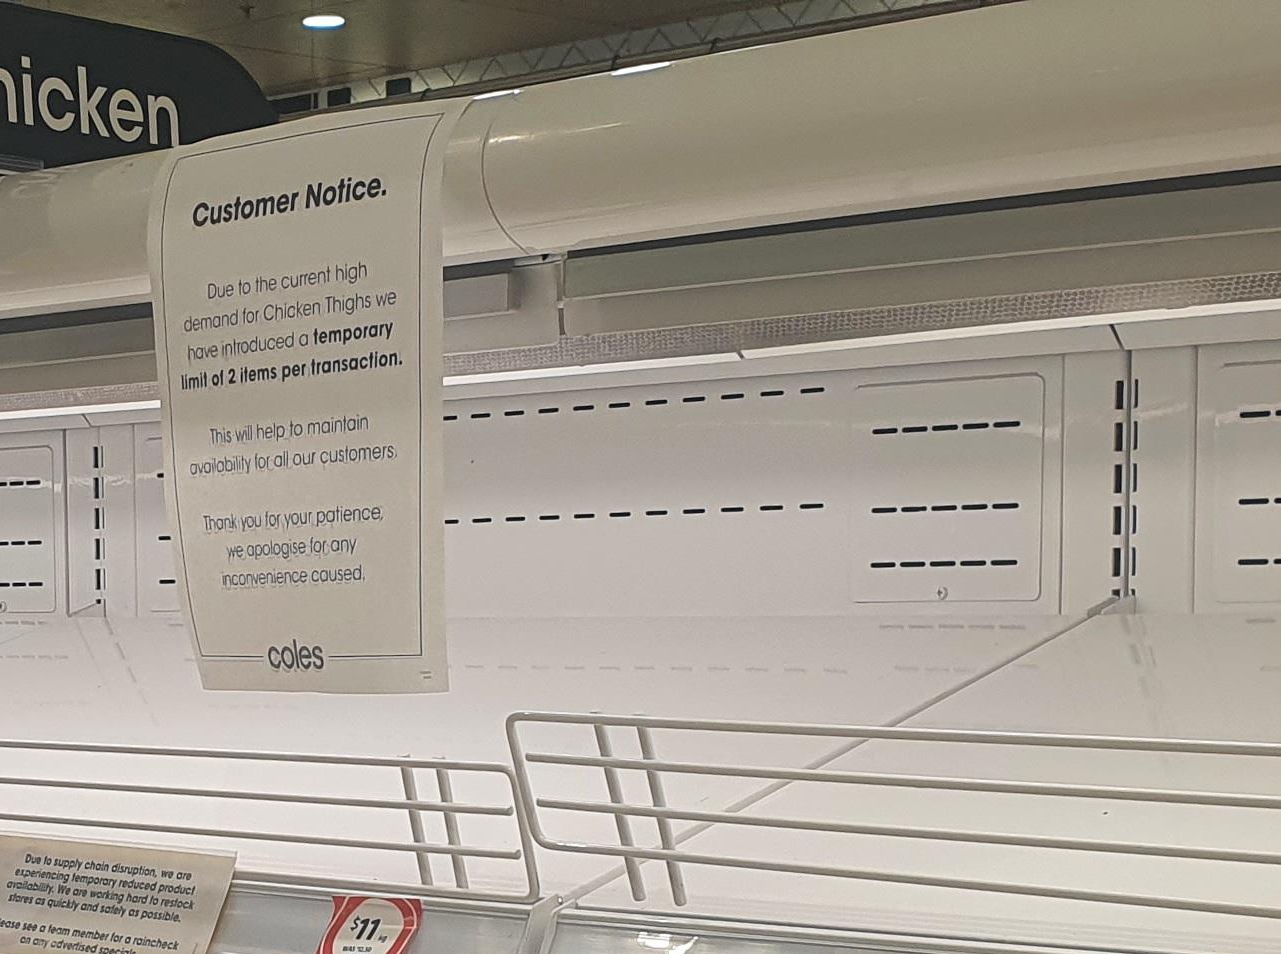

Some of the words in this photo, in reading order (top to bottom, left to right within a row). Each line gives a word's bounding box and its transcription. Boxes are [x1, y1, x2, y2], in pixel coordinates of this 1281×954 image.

[192, 191, 299, 227] Customer
[304, 177, 387, 209] Notice.
[207, 282, 234, 300] Due
[237, 278, 251, 296] to
[255, 275, 277, 293] the
[280, 265, 331, 289] current
[335, 261, 367, 284] high
[183, 308, 239, 332] demand
[241, 307, 260, 324] for
[262, 301, 321, 321] Chicken
[325, 294, 371, 316] Thighs
[375, 291, 397, 307] we
[187, 344, 218, 361] have
[221, 331, 294, 356] introduced
[298, 333, 309, 347] a
[312, 321, 393, 345] temporary
[180, 371, 207, 390] limit
[211, 369, 224, 386] of
[227, 367, 236, 385] 2
[239, 366, 277, 384] items
[281, 362, 306, 382] per
[310, 351, 403, 375] transaction.
[209, 427, 232, 445] This
[234, 424, 253, 442] will
[255, 421, 285, 442] help
[289, 420, 303, 437] to
[307, 415, 369, 435] maintain
[189, 455, 251, 475] availability
[254, 453, 270, 470] for
[273, 450, 289, 468] all
[291, 451, 316, 466] our
[202, 512, 240, 533] Thank
[240, 515, 262, 532] you
[264, 510, 281, 529] for
[282, 511, 314, 529] your
[315, 505, 384, 527] patience,
[225, 543, 245, 562] we
[246, 538, 307, 562] apologise
[309, 537, 329, 555] for
[330, 537, 359, 556] any
[221, 567, 308, 589] inconvenience
[267, 639, 325, 670] coles
[24, 853, 42, 865] Due
[42, 855, 52, 866] to
[52, 857, 83, 871] supply
[83, 859, 110, 872] chain
[160, 869, 174, 879] we
[175, 871, 192, 881] are
[6, 880, 54, 895] availability.
[56, 883, 71, 896] We
[71, 887, 88, 898] are
[89, 889, 125, 904] working
[125, 892, 149, 905] hard
[148, 894, 159, 906] to
[159, 897, 195, 910] restock
[14, 868, 70, 884] experiencing
[70, 871, 118, 889] temporary
[117, 878, 158, 892] reduced
[156, 883, 196, 896] product
[7, 892, 34, 904] stores
[34, 897, 46, 906] as
[46, 897, 80, 912] quickly
[79, 902, 100, 912] and
[99, 904, 127, 918] safely
[127, 908, 140, 918] as
[139, 909, 181, 923] possible.
[21, 922, 38, 932] see
[38, 924, 47, 933] a
[47, 923, 71, 936] team
[71, 928, 110, 941] member
[109, 931, 124, 943] for
[123, 935, 132, 944] a
[132, 935, 179, 950] raincheck
[350, 916, 381, 940] $11
[19, 935, 31, 945] on
[32, 937, 49, 949] any
[50, 939, 99, 954] advertised
